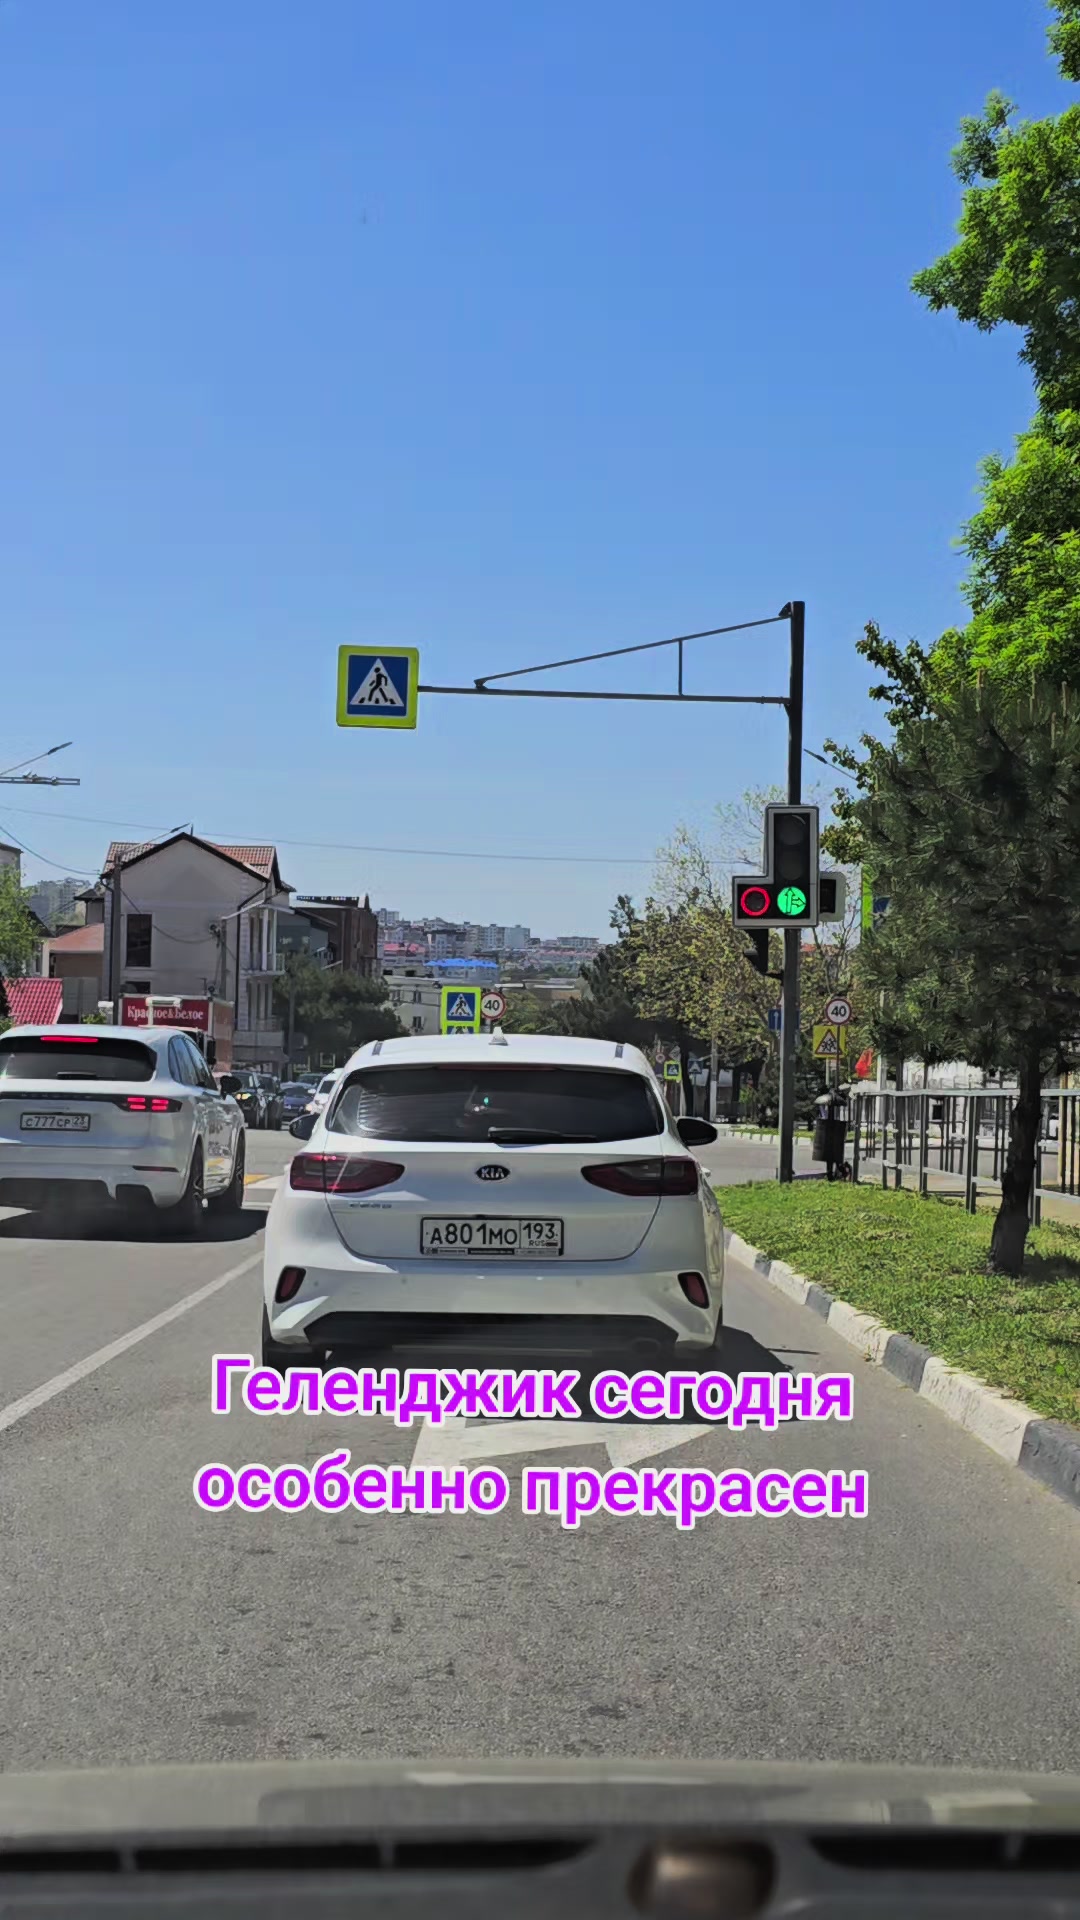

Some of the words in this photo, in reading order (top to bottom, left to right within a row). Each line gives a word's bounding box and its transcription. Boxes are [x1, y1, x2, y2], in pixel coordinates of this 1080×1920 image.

[484, 1000, 500, 1011] 40
[831, 1005, 847, 1017] 40
[481, 1167, 505, 1178] KIA
[523, 1222, 555, 1239] 193
